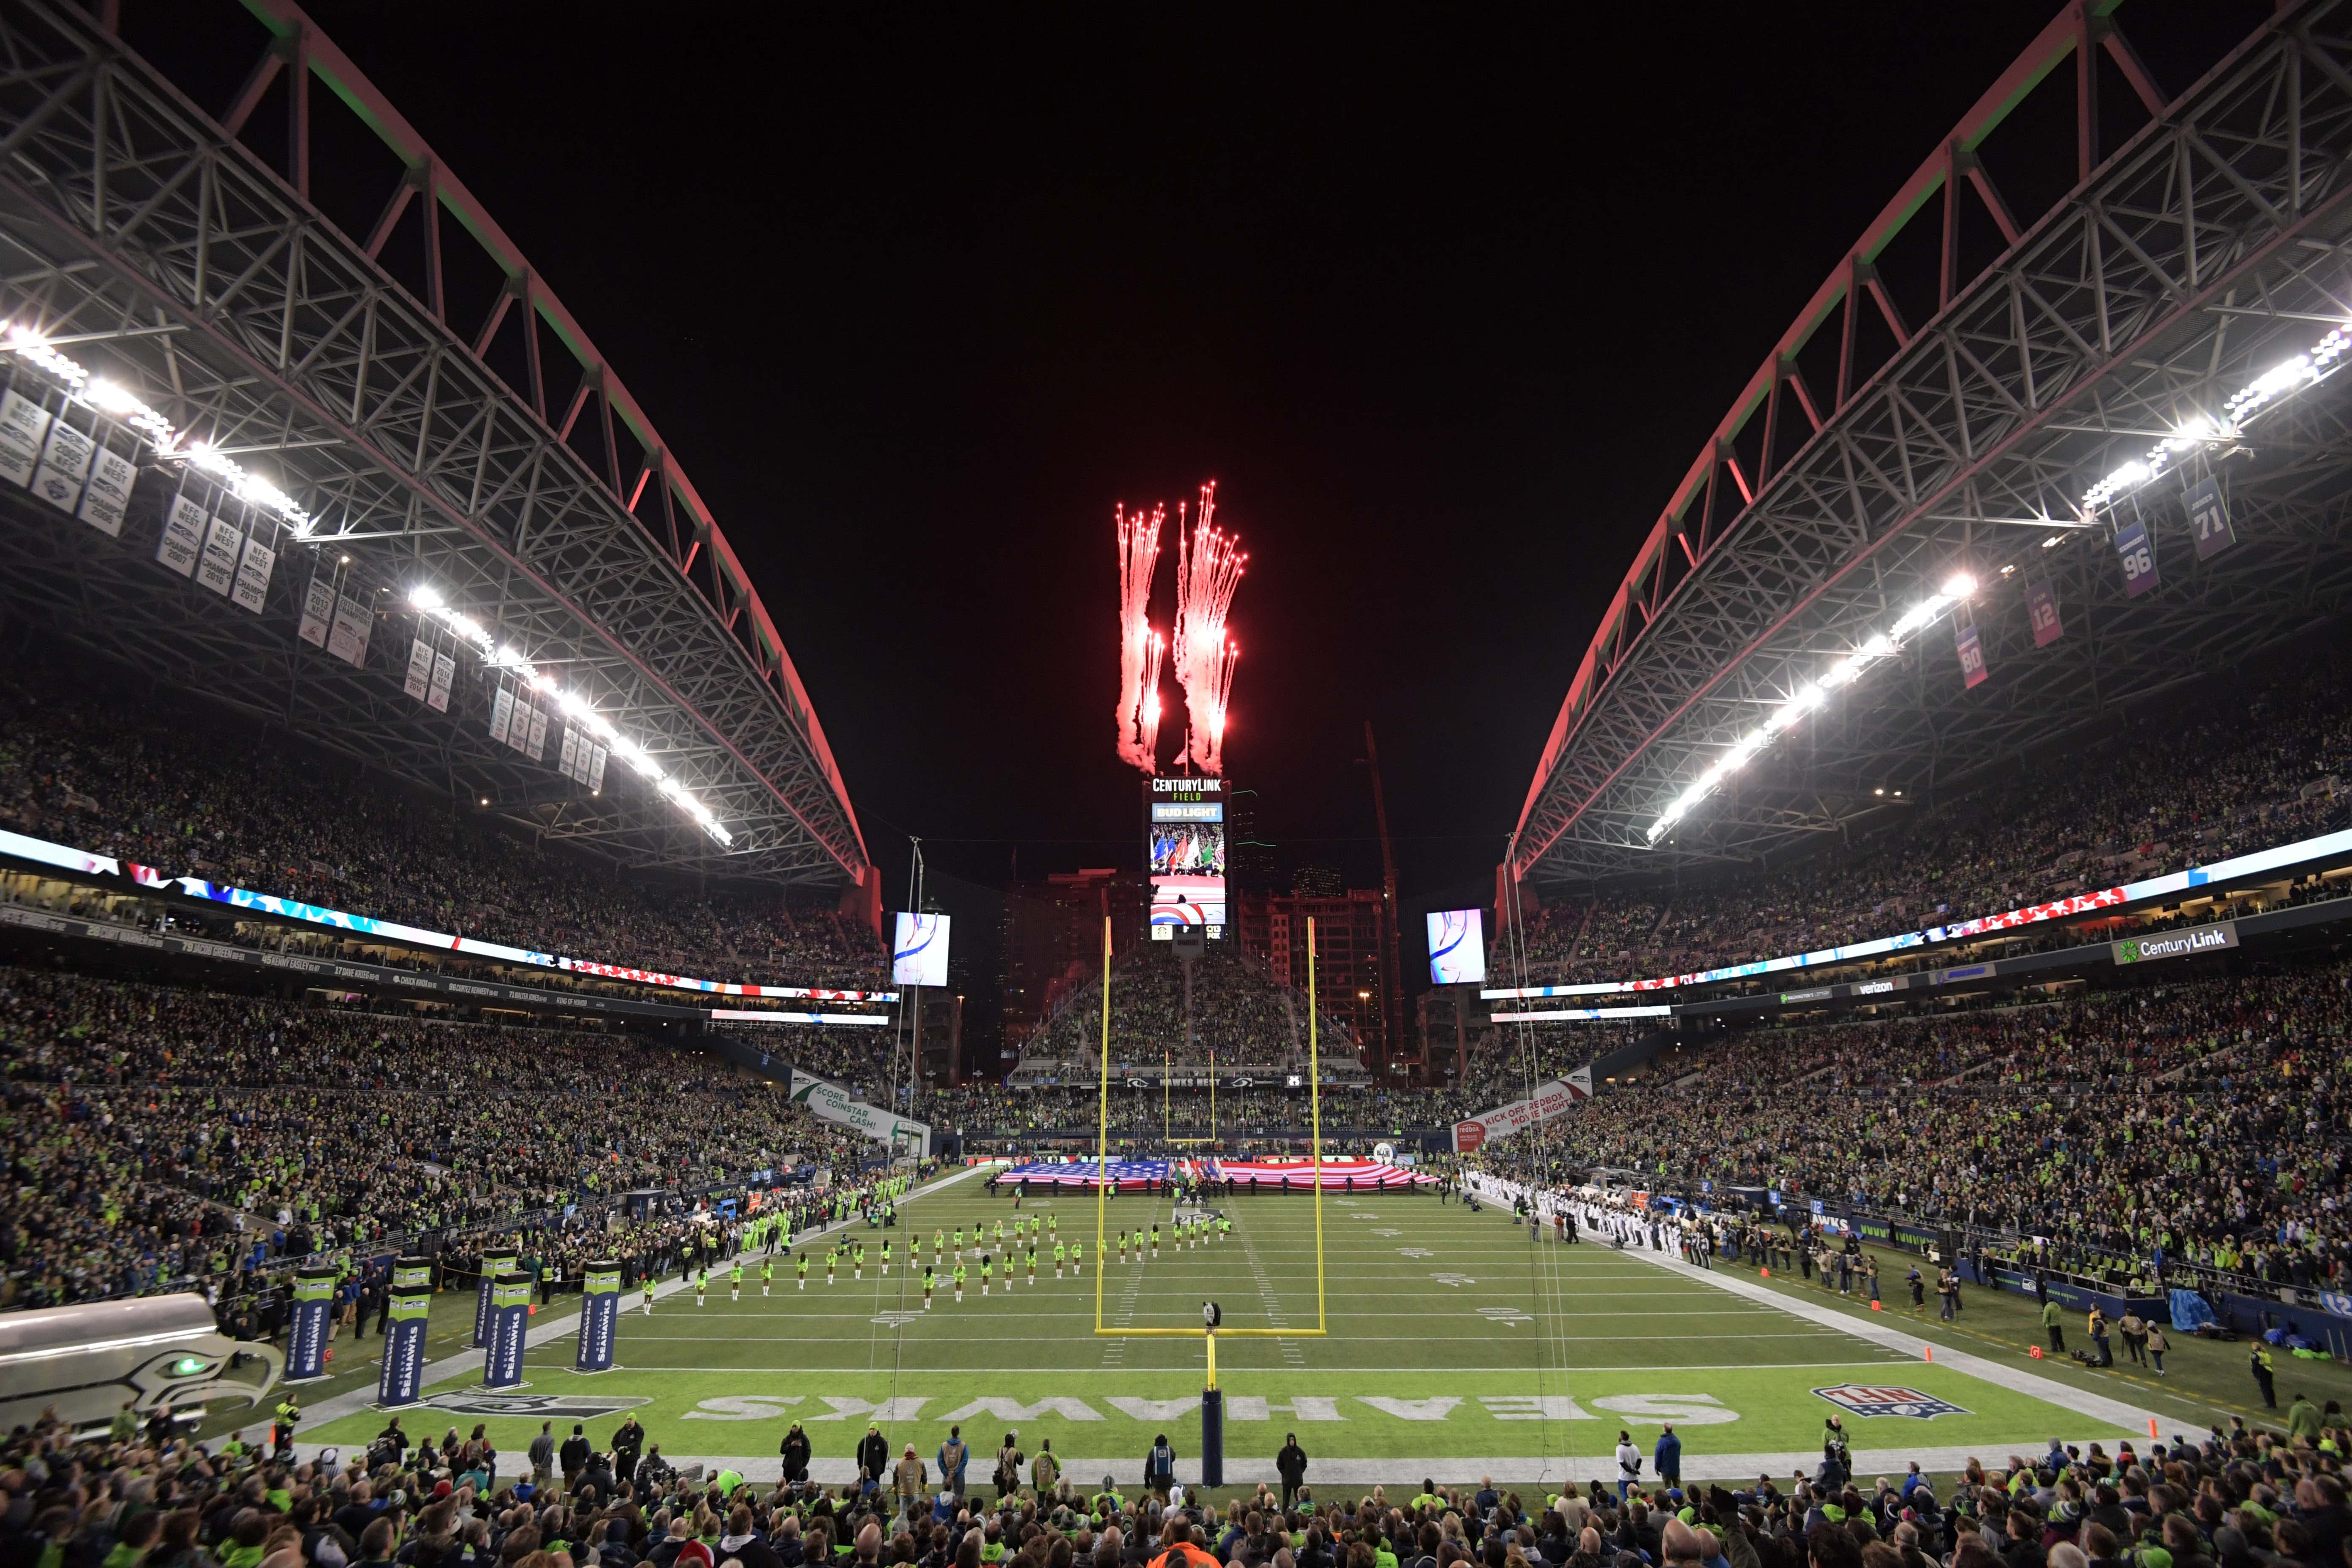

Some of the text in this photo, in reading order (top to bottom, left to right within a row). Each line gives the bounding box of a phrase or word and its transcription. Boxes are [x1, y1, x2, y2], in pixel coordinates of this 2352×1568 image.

[109, 457, 127, 473] NFC
[103, 465, 128, 484] WEST
[87, 493, 123, 518] CHAMPS
[2192, 493, 2213, 511] JONES
[183, 503, 199, 518] NFC
[178, 510, 199, 528] WEST
[2194, 506, 2224, 541] 71
[219, 524, 234, 539] NFC
[164, 536, 195, 560] CHAMPS
[215, 532, 234, 549] WEST
[168, 549, 187, 565] 2007
[249, 553, 268, 569] WEST
[253, 546, 267, 560] NFC
[202, 558, 232, 580] CHAMPS
[2123, 547, 2152, 580] 96
[206, 571, 223, 585] 2010
[237, 578, 266, 599] CHAMPS
[240, 589, 258, 604] 2013
[311, 594, 329, 610] 2013
[340, 597, 373, 621] 2013 WORLD
[312, 604, 324, 617] NFC
[338, 604, 370, 627] CHAMPIONS
[2034, 603, 2056, 631] 12
[415, 651, 428, 664] WEST
[418, 645, 428, 656] NFC
[1961, 647, 1982, 674] 80
[407, 672, 427, 688] CHAMPS
[437, 667, 450, 680] 2014
[437, 675, 446, 686] NFC
[409, 682, 422, 693] 2014
[1173, 792, 1201, 801] FIELD
[1157, 808, 1217, 817] BUD LIGHT
[182, 942, 193, 952] 79
[193, 943, 212, 956] JACOB
[212, 946, 232, 959] GREEN
[2140, 930, 2225, 956] CenturyLink
[262, 955, 272, 964] 45
[272, 957, 289, 967] KENNY
[290, 959, 309, 970] EASLEY
[335, 966, 342, 975] 17
[342, 968, 354, 977] DAVE
[355, 969, 370, 979] KRIEG
[401, 977, 415, 985] CHUCK
[416, 978, 428, 988] KNOX
[449, 983, 457, 991] 96
[456, 984, 471, 993] CORTEZ
[471, 985, 490, 995] KENNEDY
[1859, 981, 1893, 994] verizon
[514, 991, 528, 1000] WALTER
[528, 994, 539, 1002] JONES
[1160, 1078, 1221, 1087] HAWKS NEST
[816, 1087, 845, 1102] SCORE
[826, 1099, 868, 1118] COINSTAR
[1485, 1092, 1565, 1126] KICK OFF REDBOX
[1511, 1098, 1573, 1126] MOVIE NIGHT!
[849, 1116, 877, 1130] CASH!
[567, 1205, 575, 1216] 12
[1814, 1200, 1822, 1213] 12
[1812, 1214, 1848, 1231] AWKS
[478, 1283, 489, 1340] SEAHAWKS
[1475, 1307, 1533, 1320] 10
[581, 1300, 591, 1363] SEAHAWKS
[598, 1299, 611, 1362] SEAHAWKS
[289, 1306, 301, 1372] SEAHAWKS
[306, 1306, 322, 1372] SEAHAWKS
[488, 1313, 499, 1380] SEAHAWKS
[505, 1312, 520, 1379] SEAHAWKS
[2032, 1348, 2038, 1357] G
[383, 1326, 396, 1398] SEAHAWKS
[401, 1326, 418, 1397] SEAHAWKS
[1824, 1388, 1927, 1404] NFL
[679, 1394, 1741, 1425] SEAHAWKS
